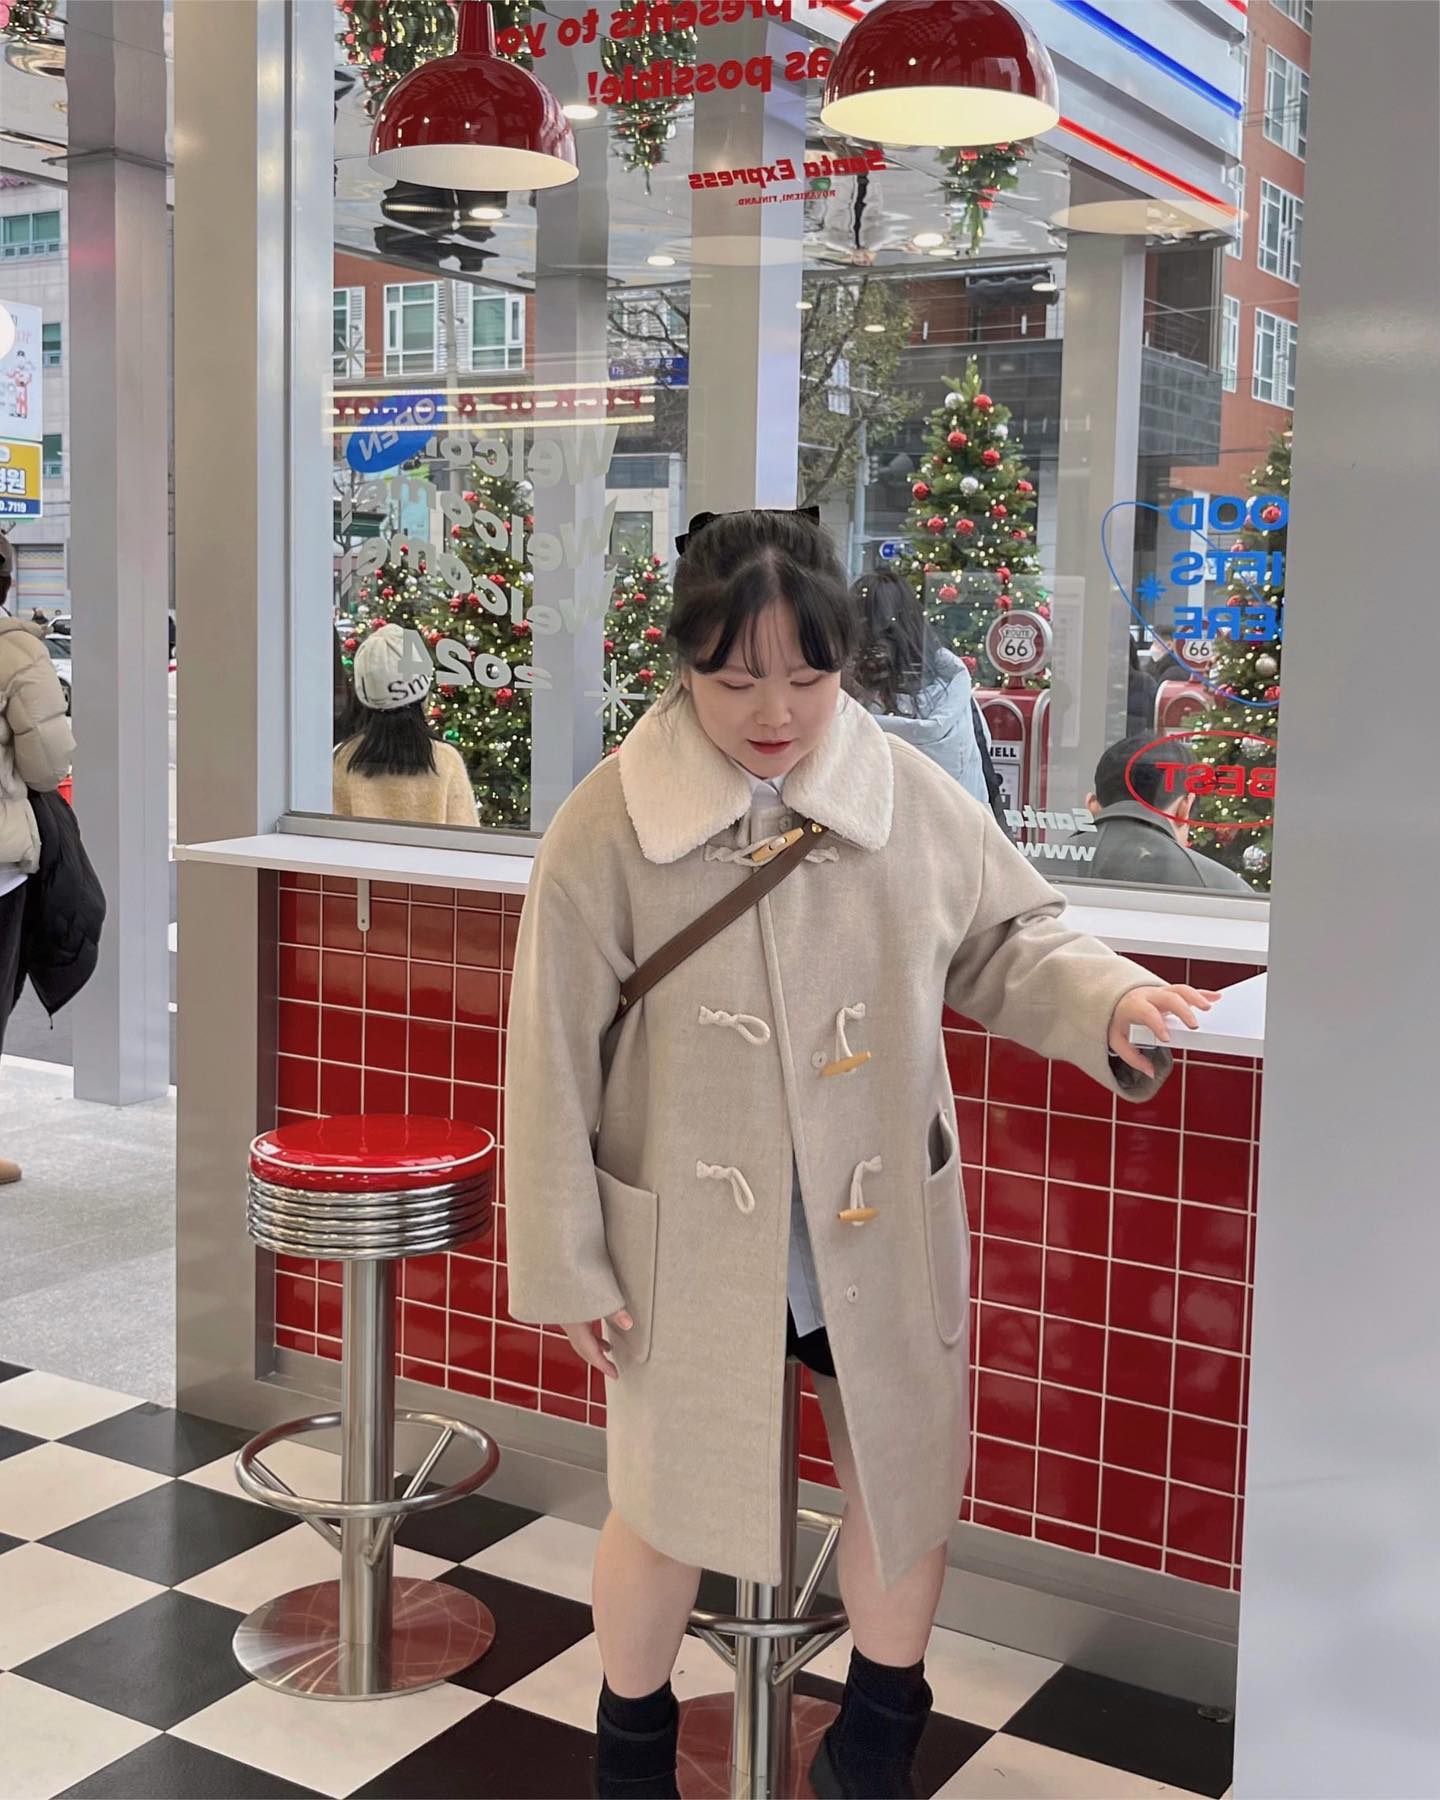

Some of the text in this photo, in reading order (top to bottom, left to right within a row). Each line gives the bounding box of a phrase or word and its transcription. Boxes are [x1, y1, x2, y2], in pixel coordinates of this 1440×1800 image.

[1005, 629, 1031, 638] ROUTE
[1004, 639, 1029, 658] 66
[1189, 641, 1210, 657] 66
[990, 746, 1017, 758] ELL
